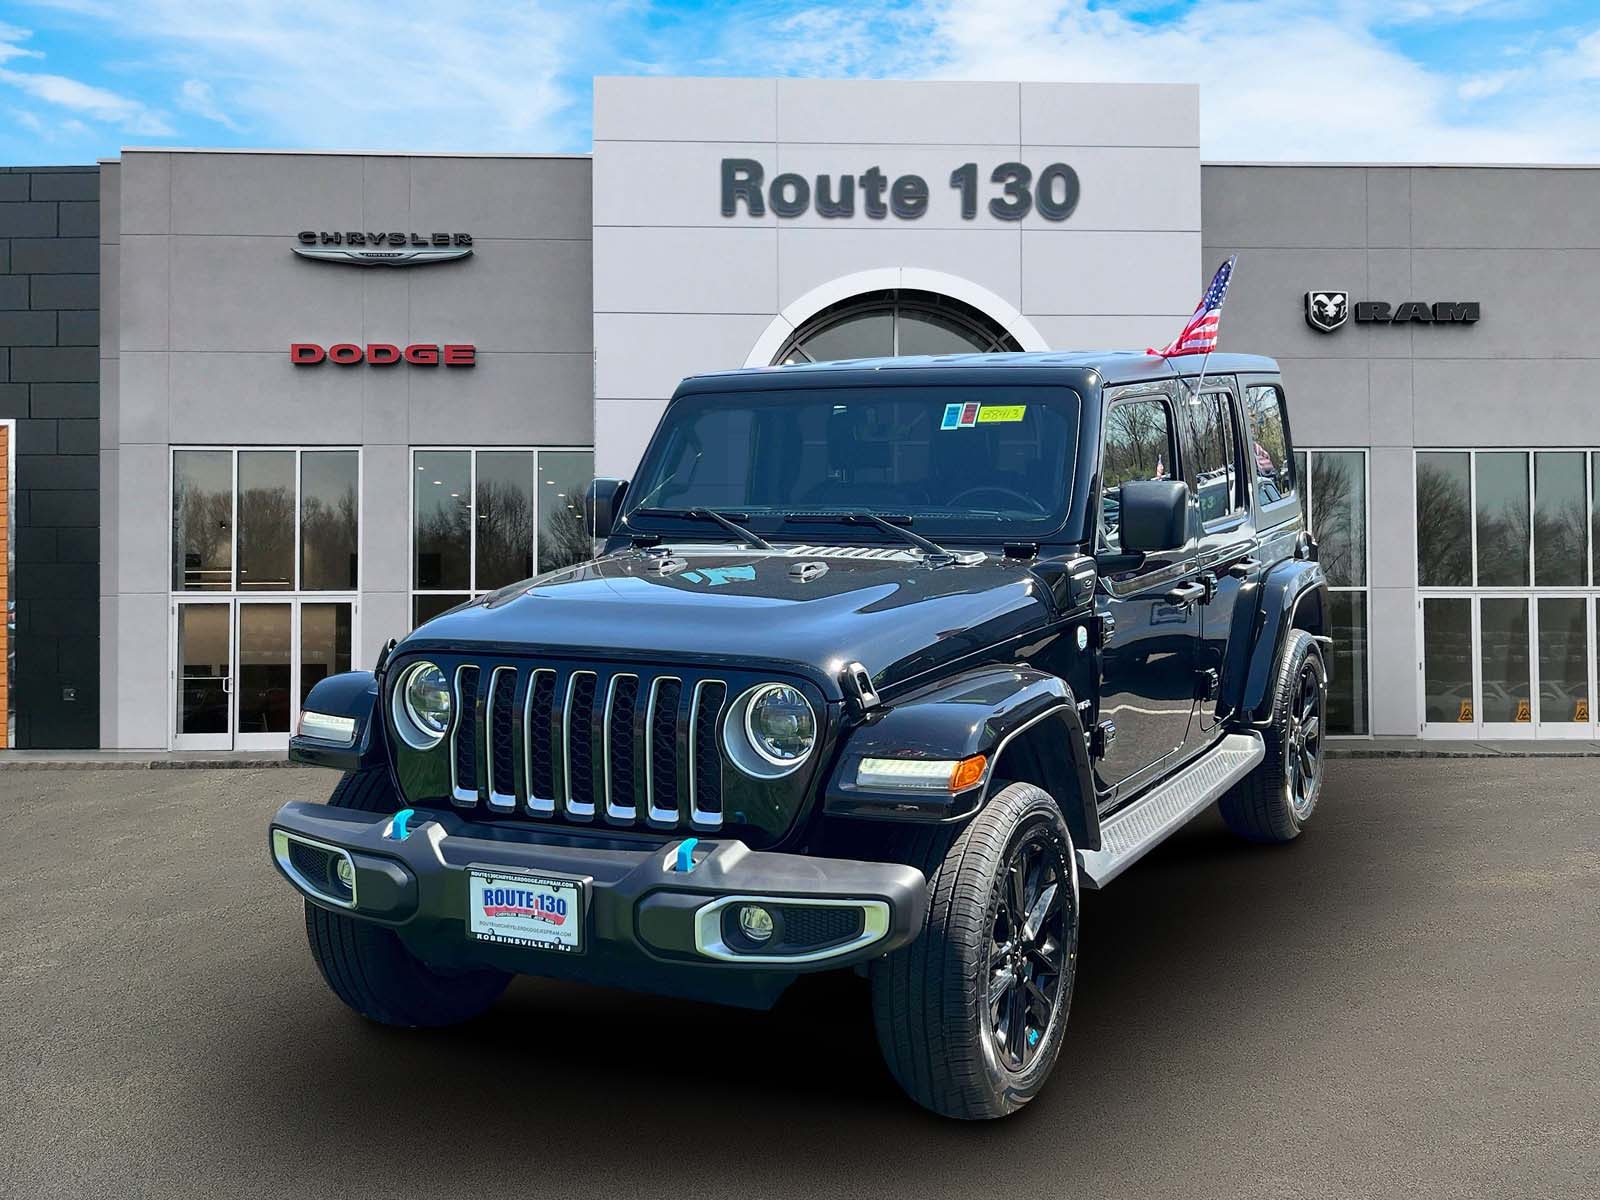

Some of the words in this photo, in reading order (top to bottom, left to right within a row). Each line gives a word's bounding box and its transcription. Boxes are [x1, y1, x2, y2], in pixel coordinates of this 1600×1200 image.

[721, 158, 929, 220] Route
[950, 162, 1080, 221] 130
[298, 231, 473, 245] CHRYSLER
[1354, 301, 1480, 323] RAM
[291, 343, 476, 364] DODGE
[484, 889, 534, 908] ROUTE
[539, 895, 567, 915] 130
[476, 933, 554, 950] ROBBINSVILLE,
[558, 944, 571, 952] NJ
